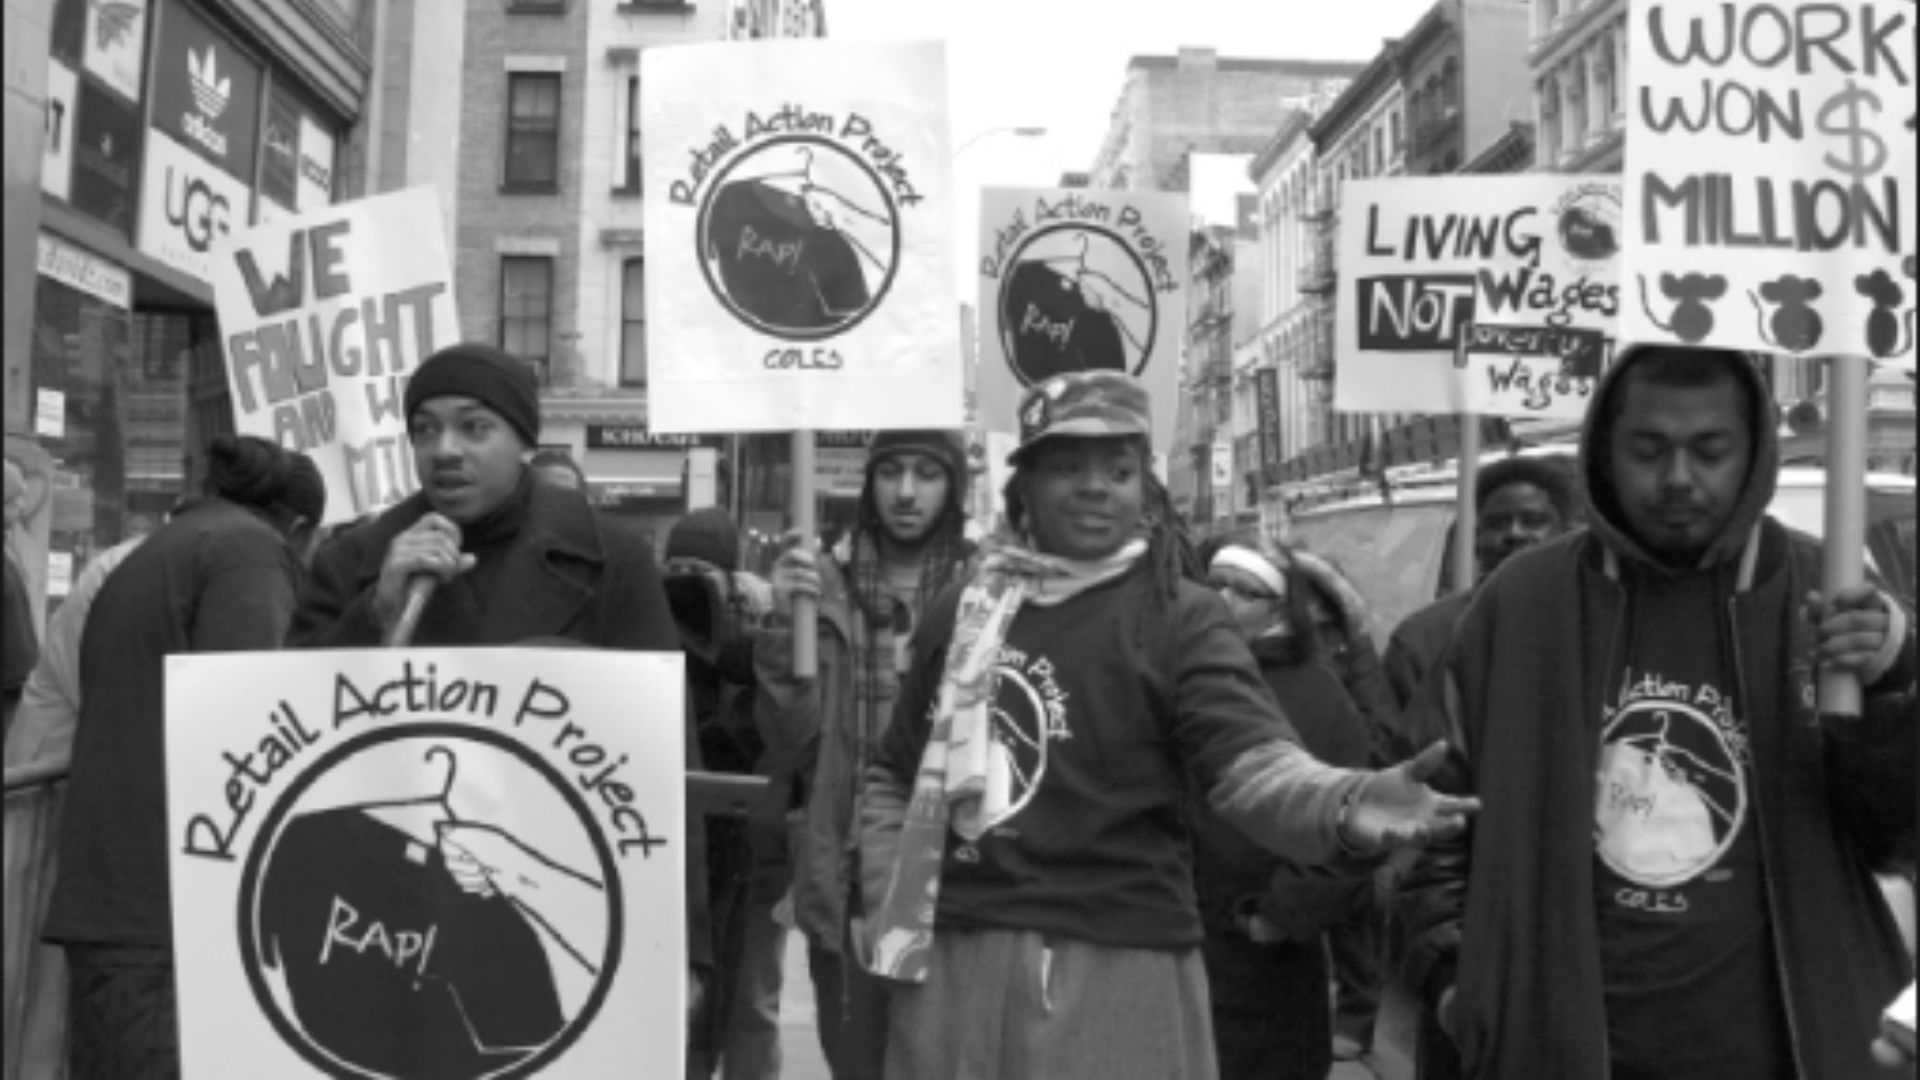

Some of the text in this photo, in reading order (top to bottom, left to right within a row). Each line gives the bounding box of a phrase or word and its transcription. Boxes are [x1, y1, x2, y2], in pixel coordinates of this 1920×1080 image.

[1647, 2, 1918, 86] WORK
[668, 103, 925, 208] Retail Action Project
[1639, 76, 1889, 184] WON $
[1035, 192, 1112, 223] Action
[1365, 202, 1542, 268] LIVING
[1641, 170, 1899, 256] MILLION
[233, 218, 351, 318] WE
[1368, 266, 1620, 340] NOT Wages
[229, 281, 446, 415] FOUGHT
[762, 347, 844, 371] COLES
[1486, 356, 1592, 411] Wages
[182, 659, 668, 863] Retail Action Project
[318, 894, 438, 992] RAP!
